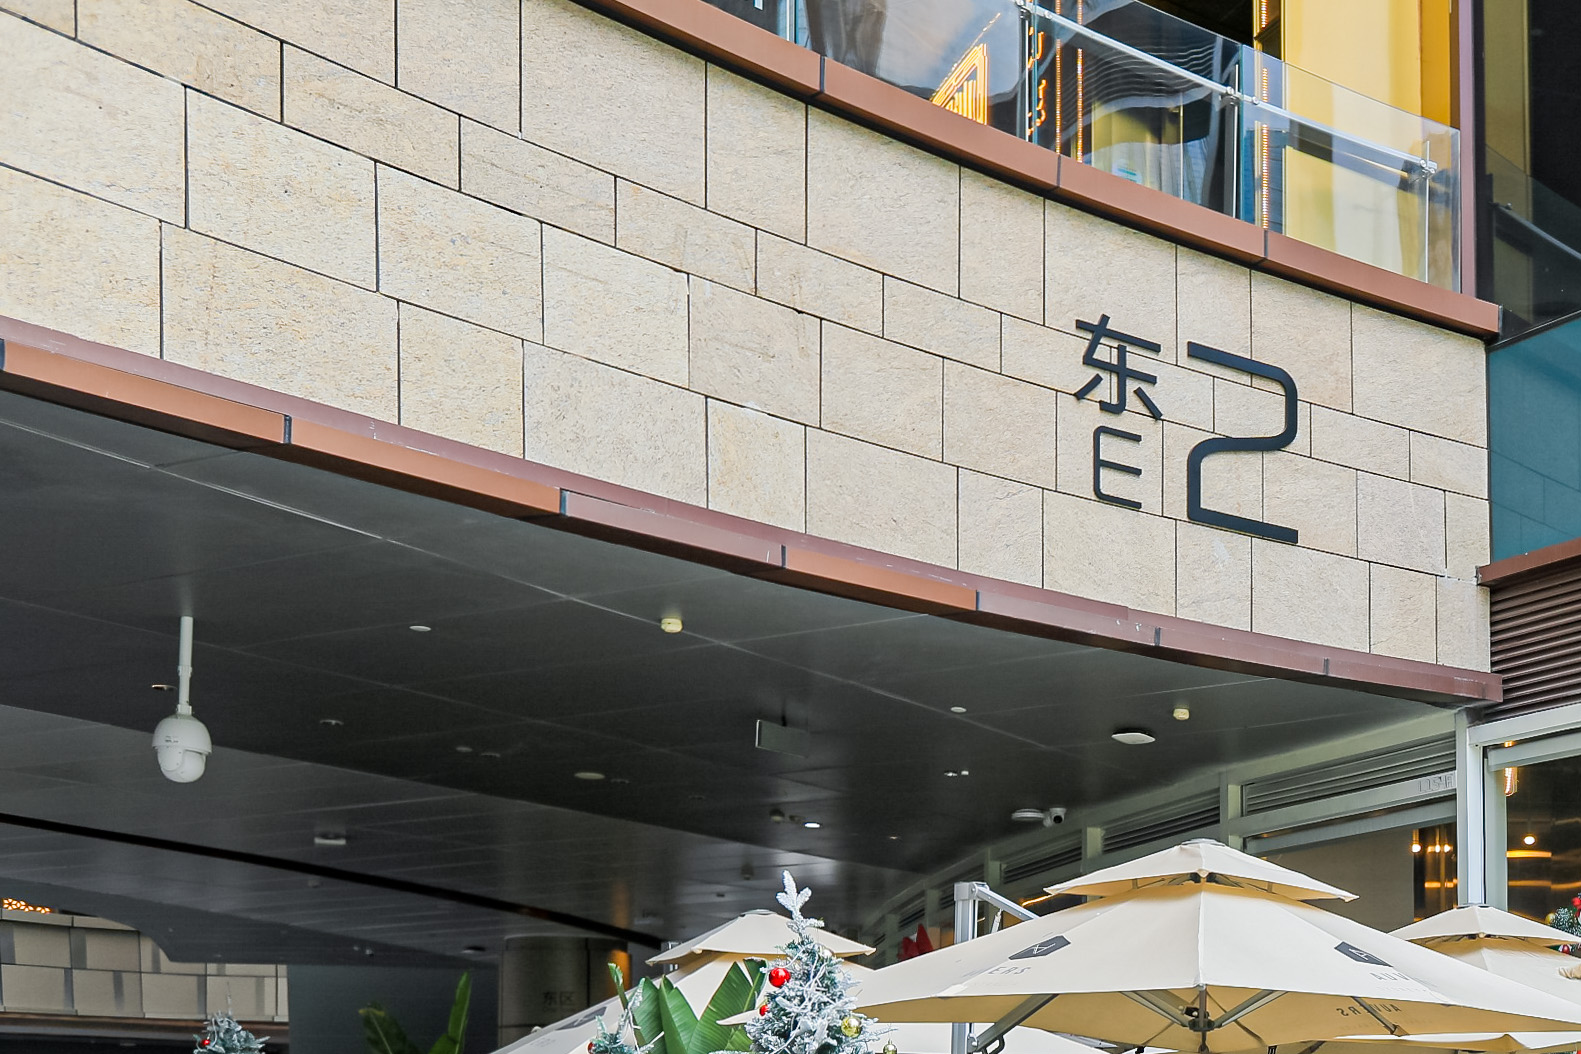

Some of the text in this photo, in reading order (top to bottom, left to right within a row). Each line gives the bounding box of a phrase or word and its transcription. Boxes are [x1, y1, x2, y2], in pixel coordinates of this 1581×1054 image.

[1075, 313, 1162, 420] 东
[1093, 425, 1143, 509] E
[1187, 341, 1299, 544] 2
